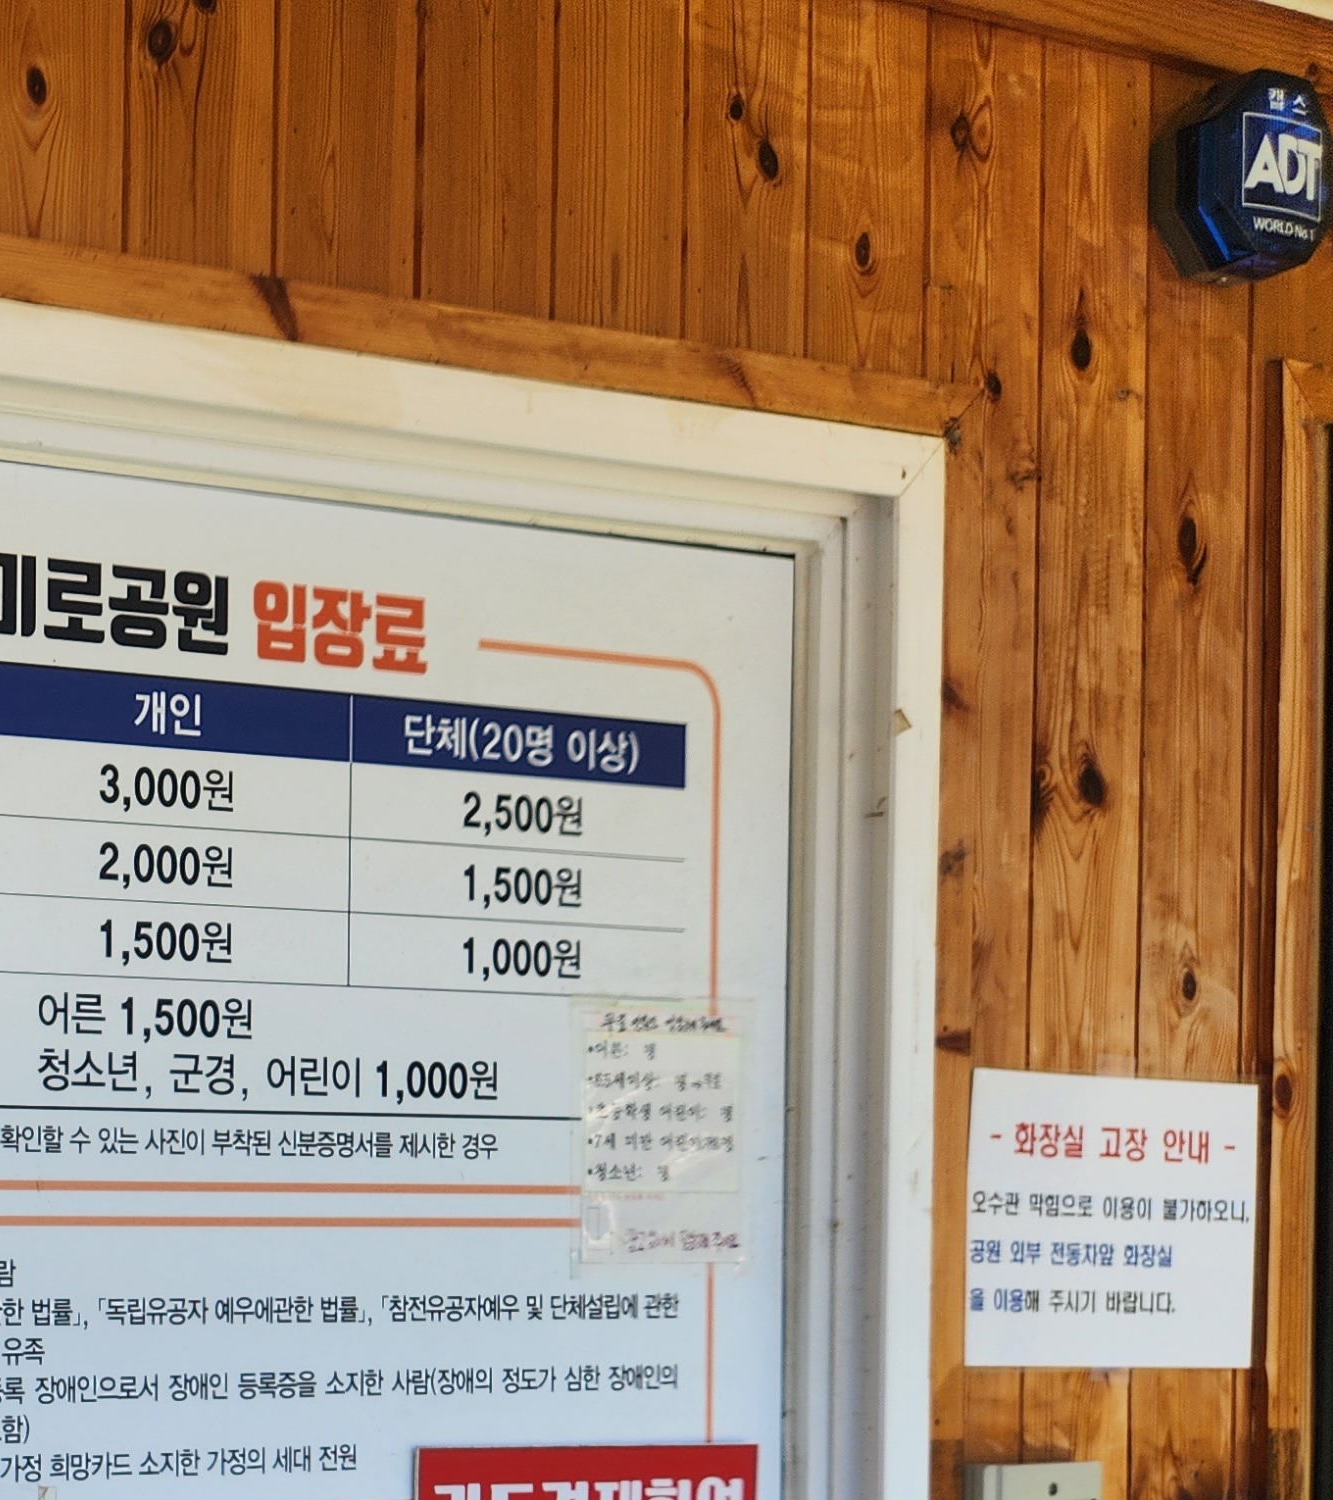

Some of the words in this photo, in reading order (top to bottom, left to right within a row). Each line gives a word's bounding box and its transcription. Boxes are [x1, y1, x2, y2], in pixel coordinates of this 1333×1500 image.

[1243, 132, 1323, 202] ADT
[1252, 216, 1294, 237] WORLD
[252, 580, 428, 675] 입장료
[133, 692, 203, 738] 개인
[403, 715, 555, 770] 단체(20명
[567, 732, 641, 774] 이상)
[99, 763, 235, 816] 3,000원
[463, 791, 585, 839] 2,500원
[98, 842, 235, 894] 2,000원
[463, 864, 584, 911] 1,500원
[99, 920, 235, 970] 1,500원
[463, 937, 583, 984] 1,000원
[38, 991, 106, 1036] 어른
[121, 996, 253, 1043] 1,500원
[37, 1048, 153, 1099] 청소년,
[169, 1052, 250, 1101] 군경,
[266, 1055, 363, 1099] 어린이
[376, 1059, 499, 1104] 1,000원
[0, 1124, 64, 1155] 확인할
[69, 1126, 92, 1155] 수
[98, 1127, 139, 1156] 있는
[144, 1128, 207, 1157] 사진이
[211, 1128, 273, 1157] 부착된
[278, 1129, 393, 1158] 신분증명서를
[399, 1131, 457, 1160] 제시한
[462, 1132, 499, 1161] 경우
[1014, 1122, 1084, 1158] 화장실
[1099, 1126, 1148, 1162] 고장
[1163, 1129, 1210, 1165] 안내
[971, 1190, 1020, 1216] 오수관
[1029, 1192, 1094, 1218] 막힘으로
[1103, 1196, 1153, 1221] 이용이
[969, 1239, 1001, 1264] 공원
[1010, 1240, 1042, 1265] 외부
[1050, 1242, 1115, 1268] 전동차앞
[1123, 1243, 1173, 1269] 화장실
[550, 1293, 639, 1321] 단체설립에
[643, 1292, 680, 1320] 관한
[993, 1288, 1040, 1313] 이용해
[1049, 1289, 1096, 1315] 주시기
[1105, 1291, 1176, 1316] 바랍니다.
[2, 1337, 45, 1367] 유족
[35, 1374, 159, 1405] 장애인으로서
[168, 1372, 228, 1402] 장애인
[238, 1370, 317, 1400] 등록증을
[324, 1368, 384, 1398] 소지한
[391, 1366, 493, 1397] 사람(장애의
[502, 1365, 556, 1394] 정도가
[564, 1364, 601, 1392] 심한
[608, 1362, 678, 1391] 장애인의
[0, 1453, 42, 1483] 가정
[49, 1450, 133, 1482] 희망카드
[138, 1448, 200, 1477] 소지한
[206, 1446, 265, 1475] 가정의
[272, 1445, 312, 1473] 세대
[318, 1443, 357, 1472] 전원
